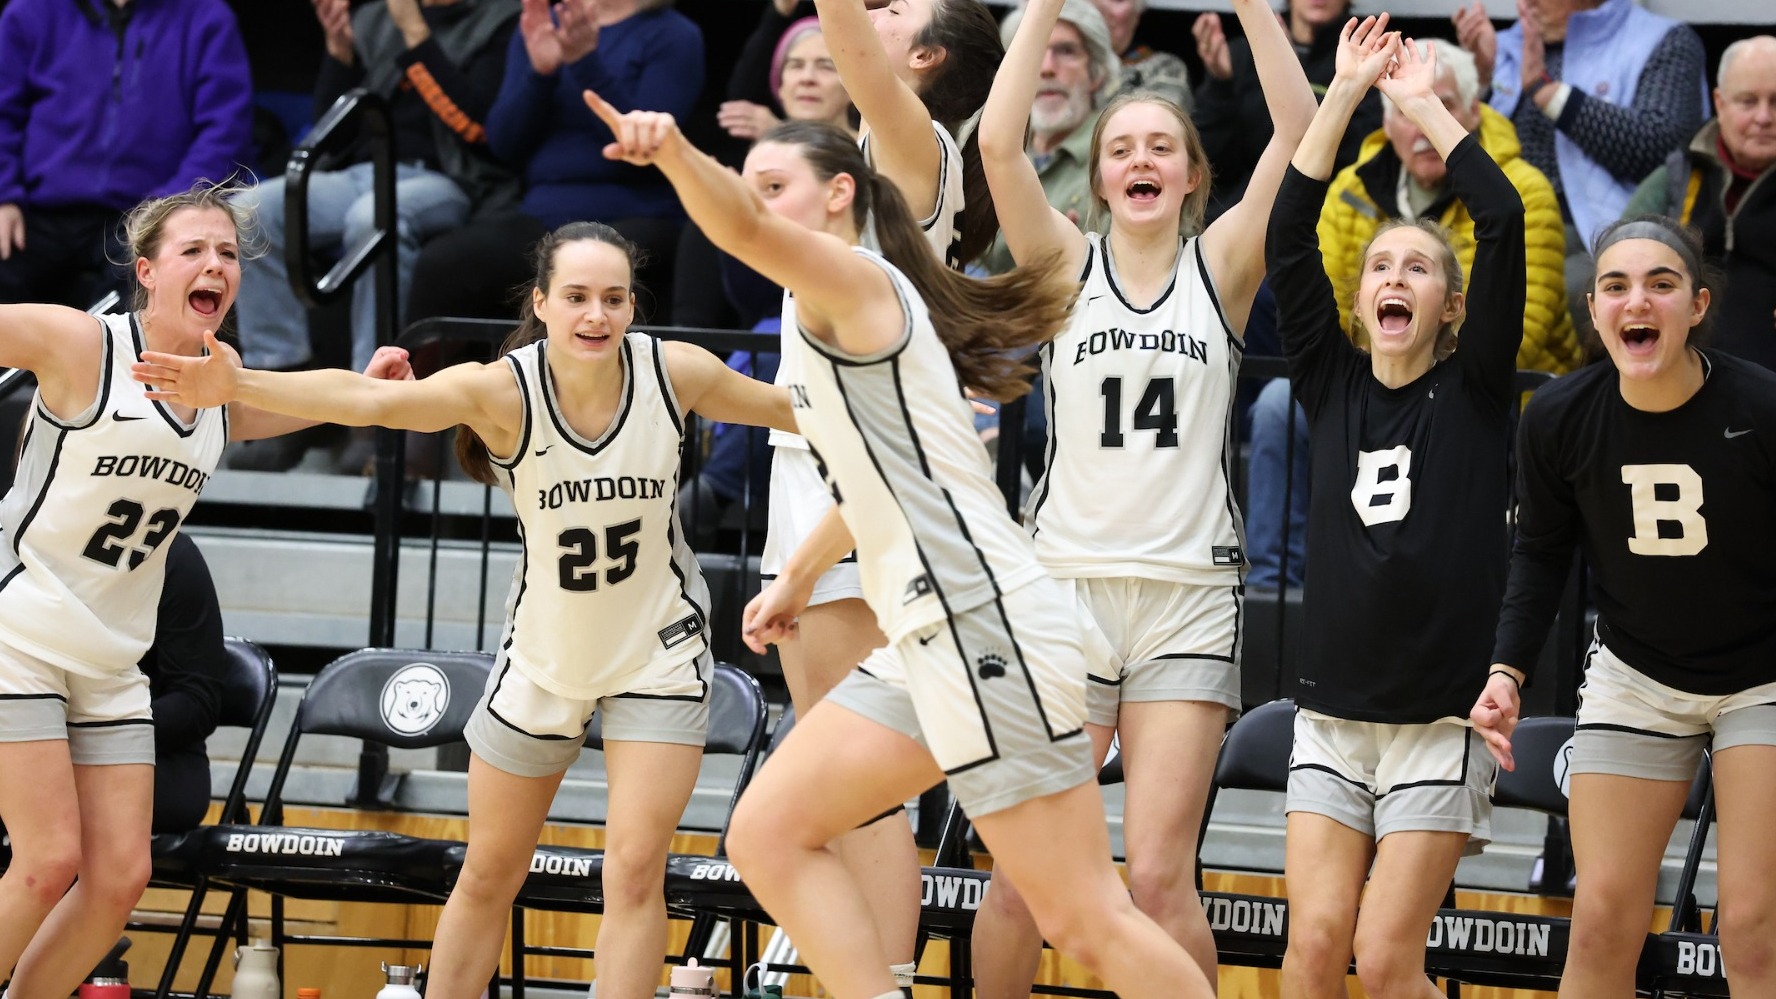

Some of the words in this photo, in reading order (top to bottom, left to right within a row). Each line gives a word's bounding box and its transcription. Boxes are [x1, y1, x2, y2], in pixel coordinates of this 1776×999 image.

[1099, 375, 1181, 450] 14
[90, 455, 211, 495] BOWDOI
[1350, 444, 1412, 527] B
[1620, 463, 1709, 556] B
[80, 497, 182, 573] 23
[556, 516, 643, 593] 25
[687, 620, 698, 631] M
[226, 833, 346, 856] BOWDOIN
[528, 854, 593, 877] DOIN
[1200, 896, 1286, 936] DOIN
[1425, 915, 1551, 957] OWDOIN
